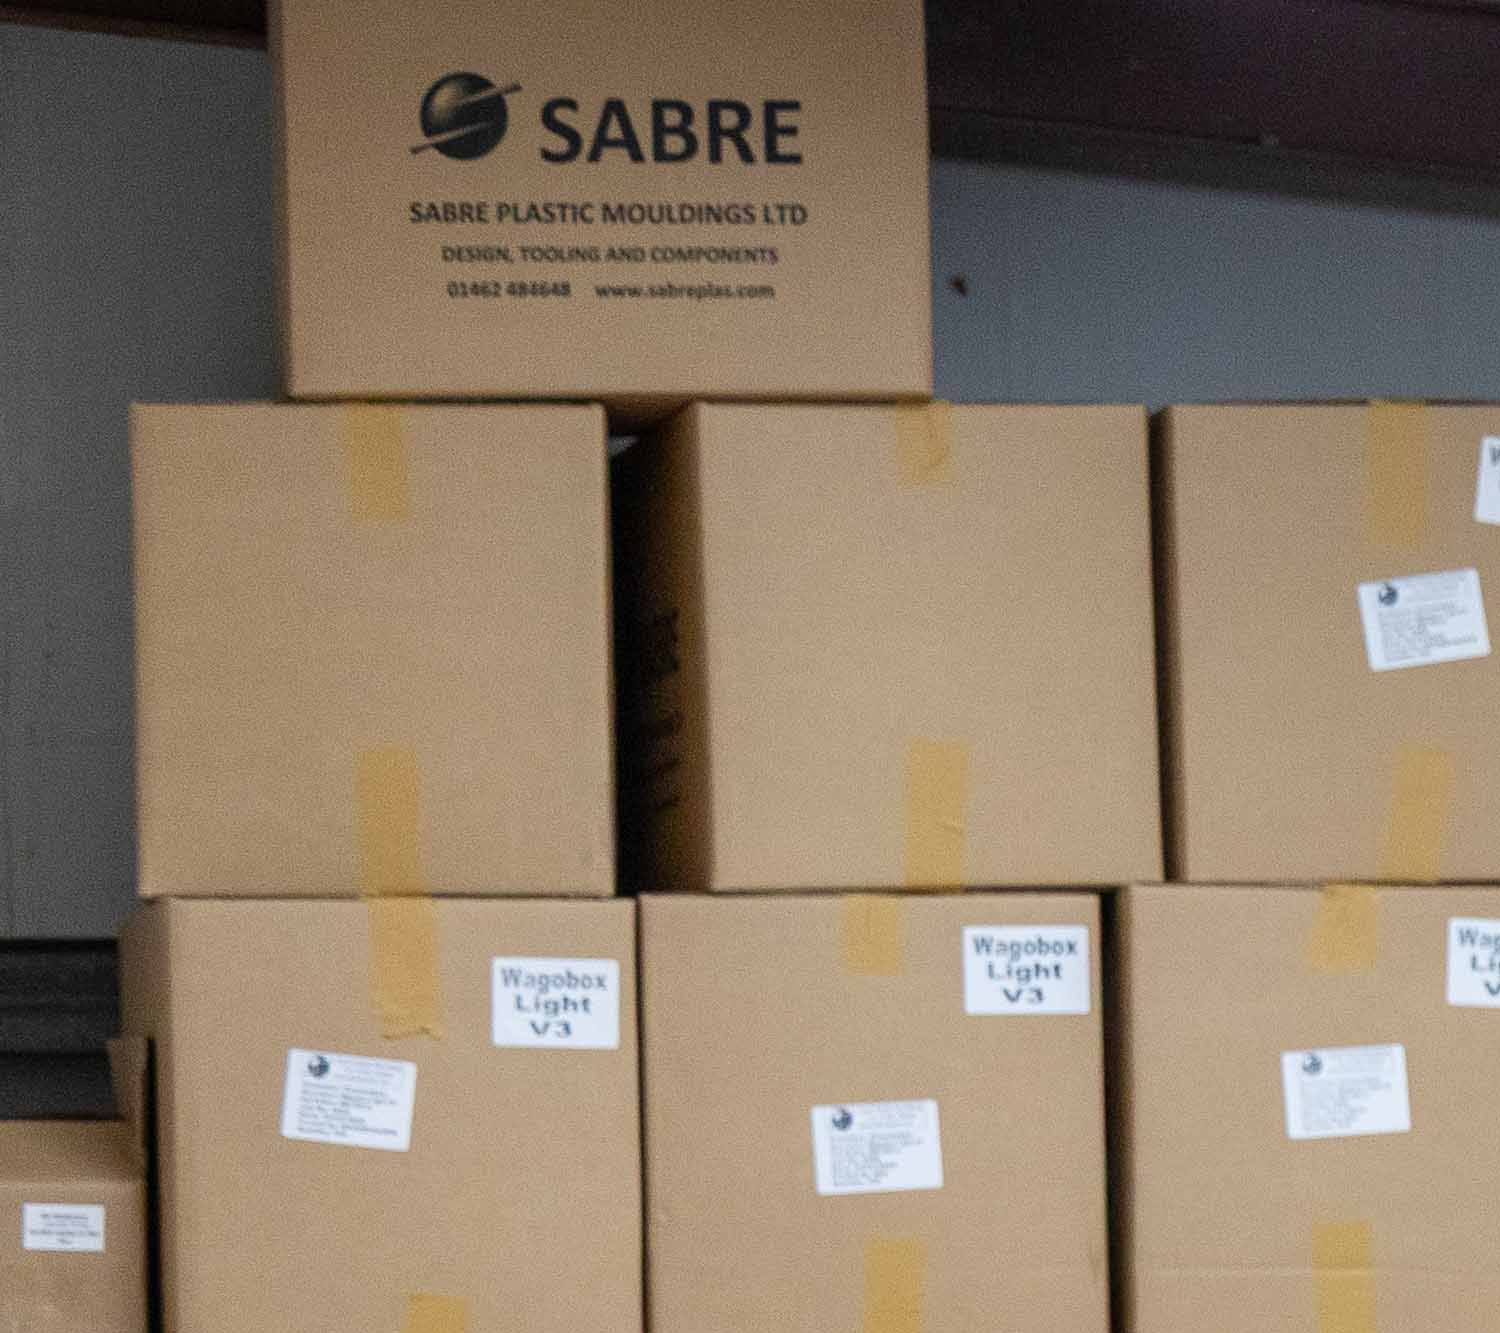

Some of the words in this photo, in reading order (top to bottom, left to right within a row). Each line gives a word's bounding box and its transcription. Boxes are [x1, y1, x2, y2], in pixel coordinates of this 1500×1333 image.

[540, 97, 803, 165] SABRE
[409, 202, 488, 226] SABRE
[497, 202, 593, 226] PLASTIC
[601, 202, 756, 226] MOULDINGS
[763, 202, 809, 226] LTD
[442, 245, 513, 265] DESIGN,
[521, 246, 600, 264] TOOLING
[606, 246, 646, 264] AND
[650, 246, 778, 265] COMPONENTS
[595, 281, 775, 302] www.sabreplas.com
[972, 936, 1078, 962] Wagobox
[500, 967, 607, 994] Wagobox
[987, 963, 1062, 985] Light
[514, 994, 592, 1016] Light
[1002, 987, 1044, 1004] V3
[529, 1020, 573, 1038] V3
